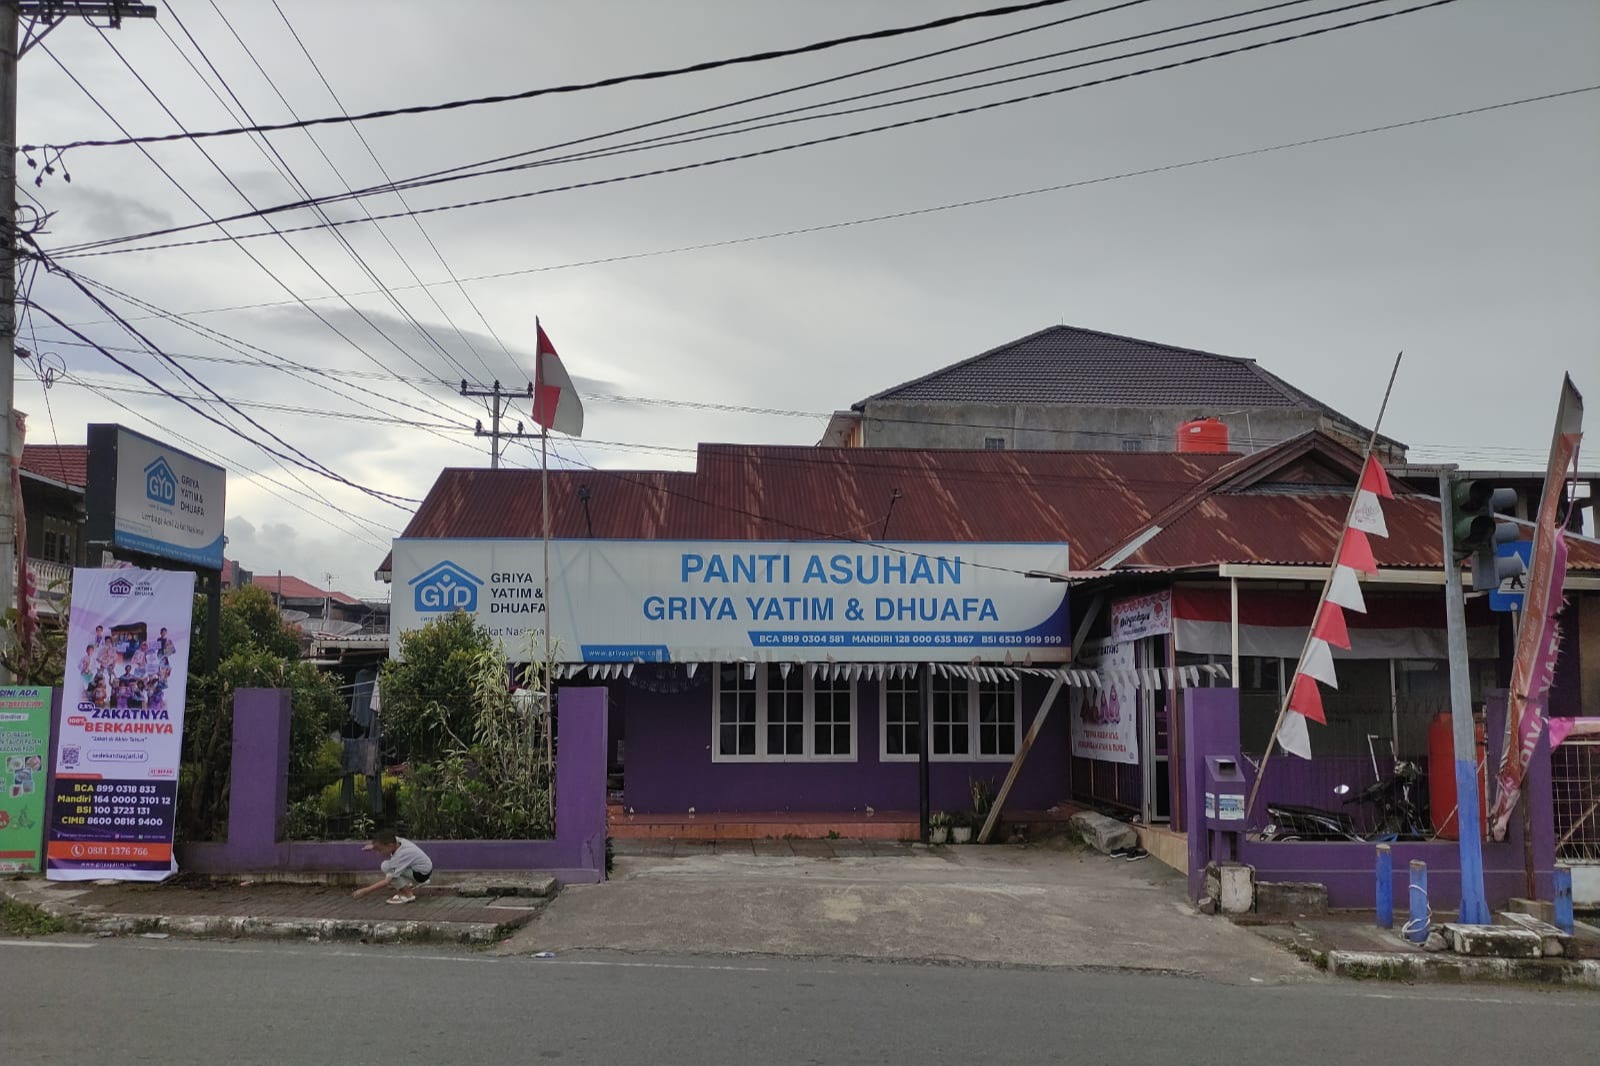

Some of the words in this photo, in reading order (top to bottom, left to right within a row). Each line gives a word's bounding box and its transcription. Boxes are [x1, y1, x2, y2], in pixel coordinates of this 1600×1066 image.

[149, 473, 173, 500] GYD
[181, 475, 200, 490] GRIYA
[181, 488, 199, 502] YATIM
[181, 501, 205, 517] DHUAFA
[681, 554, 790, 585] PANTI
[802, 554, 961, 585] ASUHAN
[491, 573, 533, 583] GRIYA
[420, 582, 472, 607] GYD
[491, 588, 532, 598] YATIM
[535, 588, 544, 598] &
[491, 603, 546, 613] DHUAFA
[643, 597, 737, 621] GRIYA
[746, 597, 834, 621] YATIM
[845, 597, 865, 621] &
[876, 597, 999, 621] DHUAFA
[759, 635, 780, 643] BCA
[781, 635, 799, 643] 899
[802, 635, 827, 643] 0304
[829, 635, 845, 644] 581
[852, 635, 893, 644] MANDIRI
[895, 635, 910, 644] 128
[912, 635, 932, 644] 000
[934, 636, 951, 644] 635
[953, 636, 974, 644] 1867
[981, 636, 997, 644] BSI
[999, 636, 1022, 644] 6530
[1024, 636, 1042, 645] 999
[1044, 636, 1062, 645] 999
[92, 708, 169, 720] ZAKATNYA
[85, 722, 174, 734] BERKAHNYA
[74, 784, 94, 792] BCA
[96, 784, 113, 792] 899
[116, 785, 137, 793] 0318
[139, 785, 156, 793] 833
[57, 794, 91, 803] Mandiri
[94, 795, 109, 804] 164
[111, 796, 137, 804] 0000
[139, 796, 159, 804] 3101
[76, 806, 91, 814] BSI
[94, 806, 110, 814] 100
[113, 806, 135, 814] 3723
[61, 816, 85, 824] CIMB
[87, 817, 111, 825] 8600
[114, 817, 135, 825] 0816
[88, 846, 107, 855] 0881
[111, 847, 131, 855] 1376
[133, 847, 149, 855] 766
